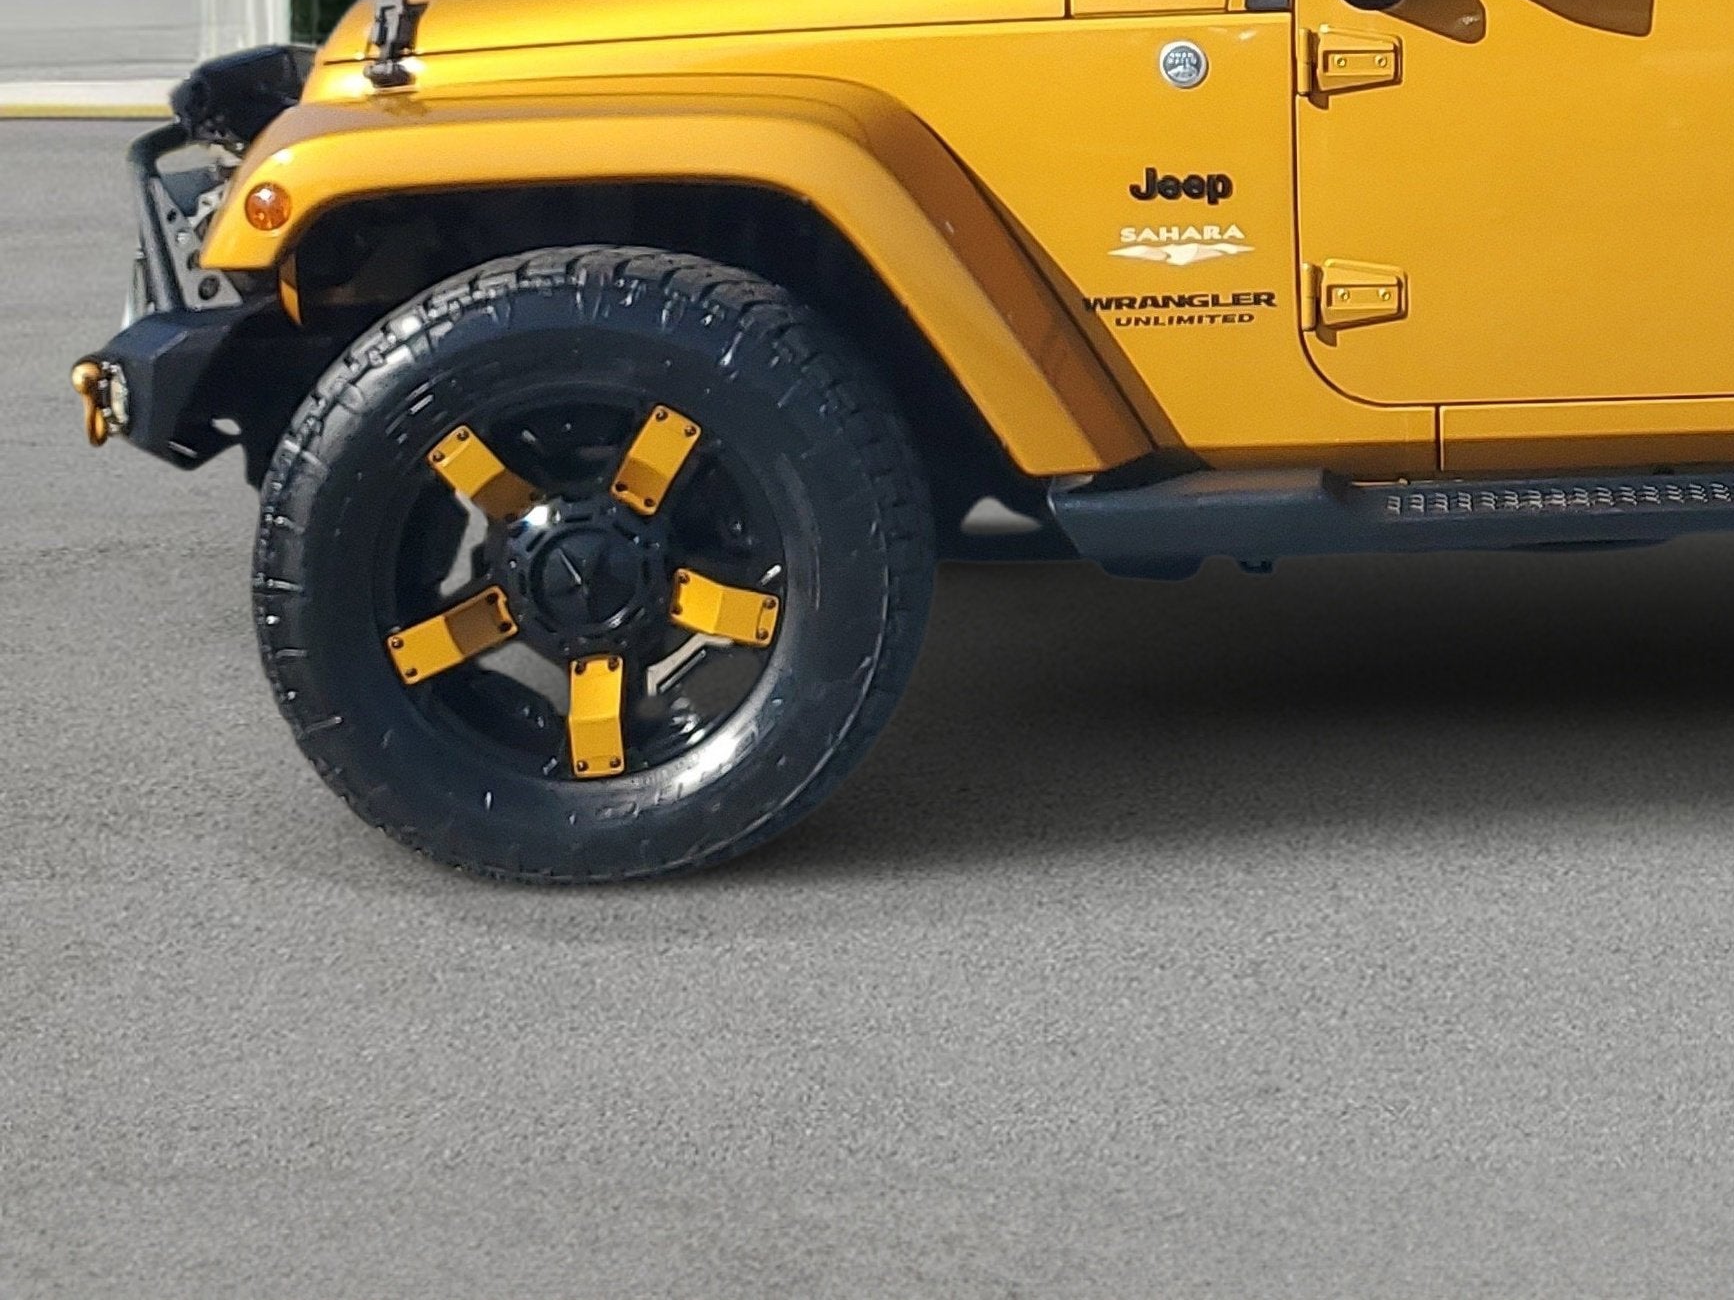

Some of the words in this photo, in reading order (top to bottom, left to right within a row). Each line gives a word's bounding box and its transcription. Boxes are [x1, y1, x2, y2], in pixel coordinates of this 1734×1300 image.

[1129, 167, 1233, 205] Jeep
[1119, 224, 1246, 243] SAHARA
[1083, 291, 1277, 312] WRANGLER
[1114, 313, 1255, 327] UNLIMITED
